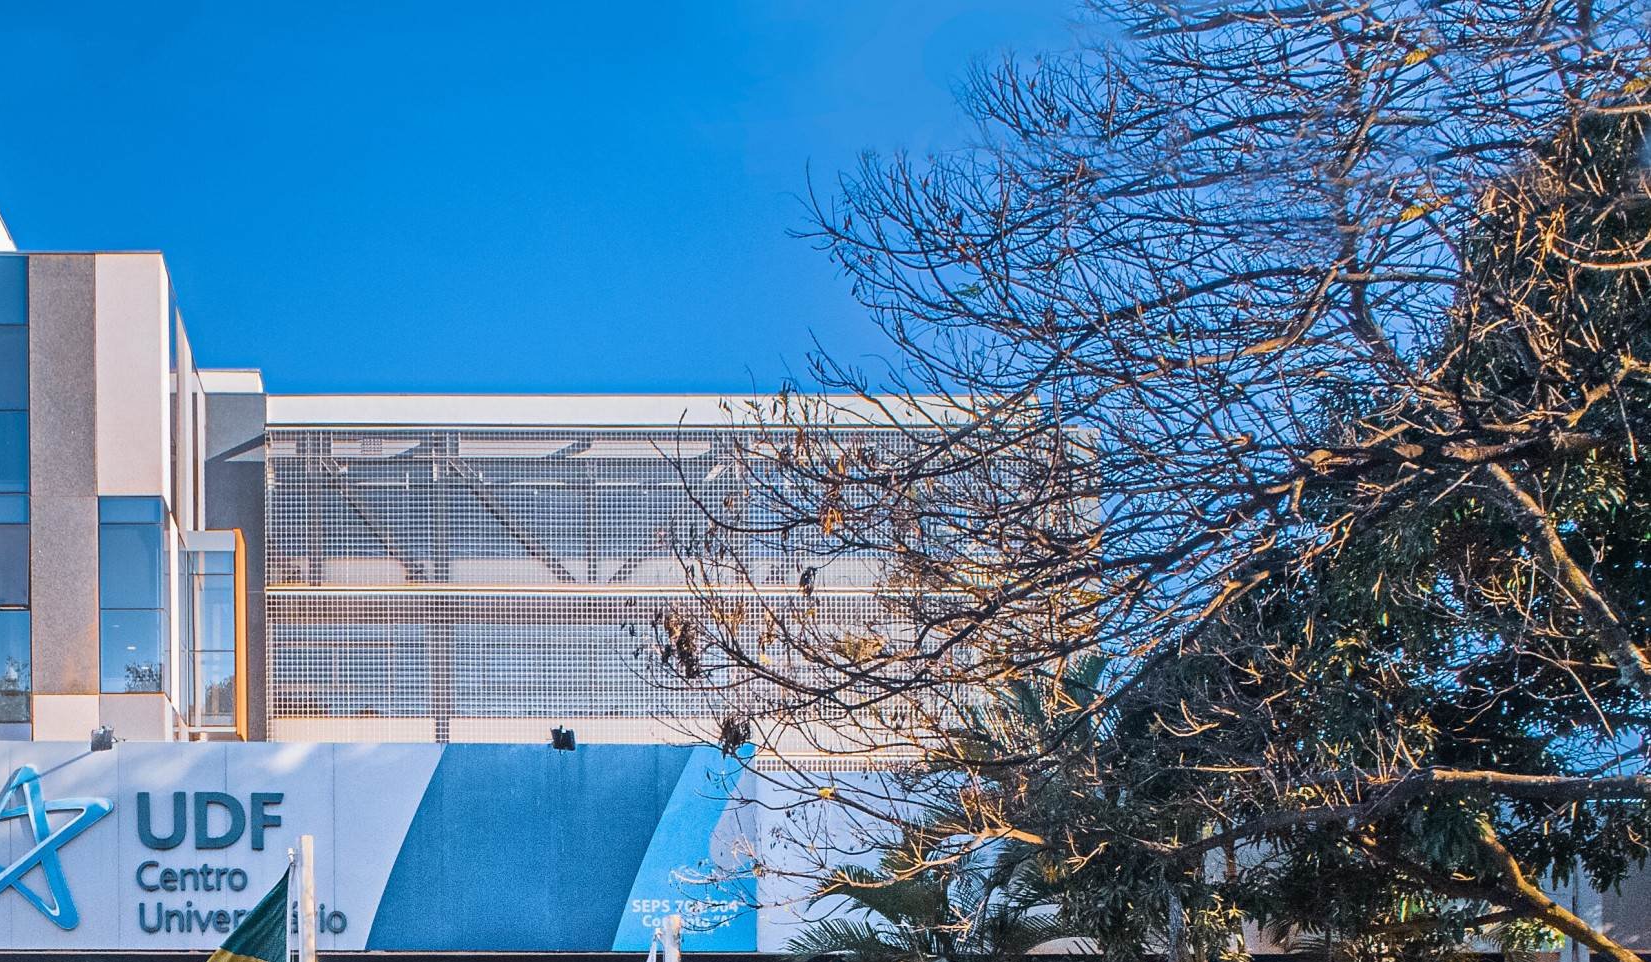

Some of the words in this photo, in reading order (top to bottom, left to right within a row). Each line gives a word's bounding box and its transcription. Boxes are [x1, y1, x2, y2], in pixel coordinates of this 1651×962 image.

[136, 791, 285, 851] UDF
[136, 860, 249, 892] Centro
[632, 899, 670, 912] SEPS
